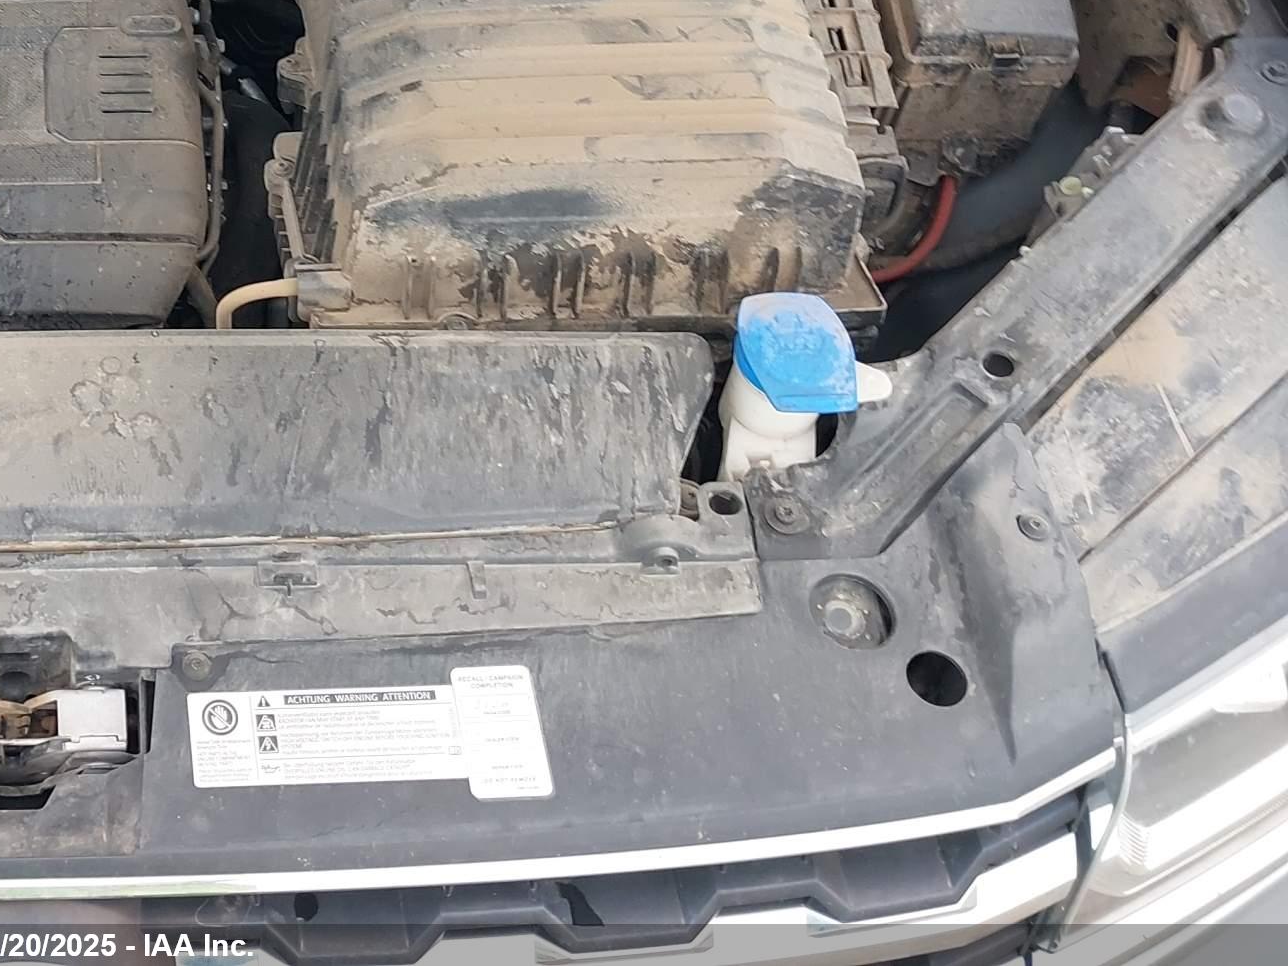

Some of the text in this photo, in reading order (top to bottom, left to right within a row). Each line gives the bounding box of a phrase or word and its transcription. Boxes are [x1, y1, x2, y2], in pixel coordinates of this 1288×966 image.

[287, 691, 431, 704] ACHTUNG WARNING ATTENTION
